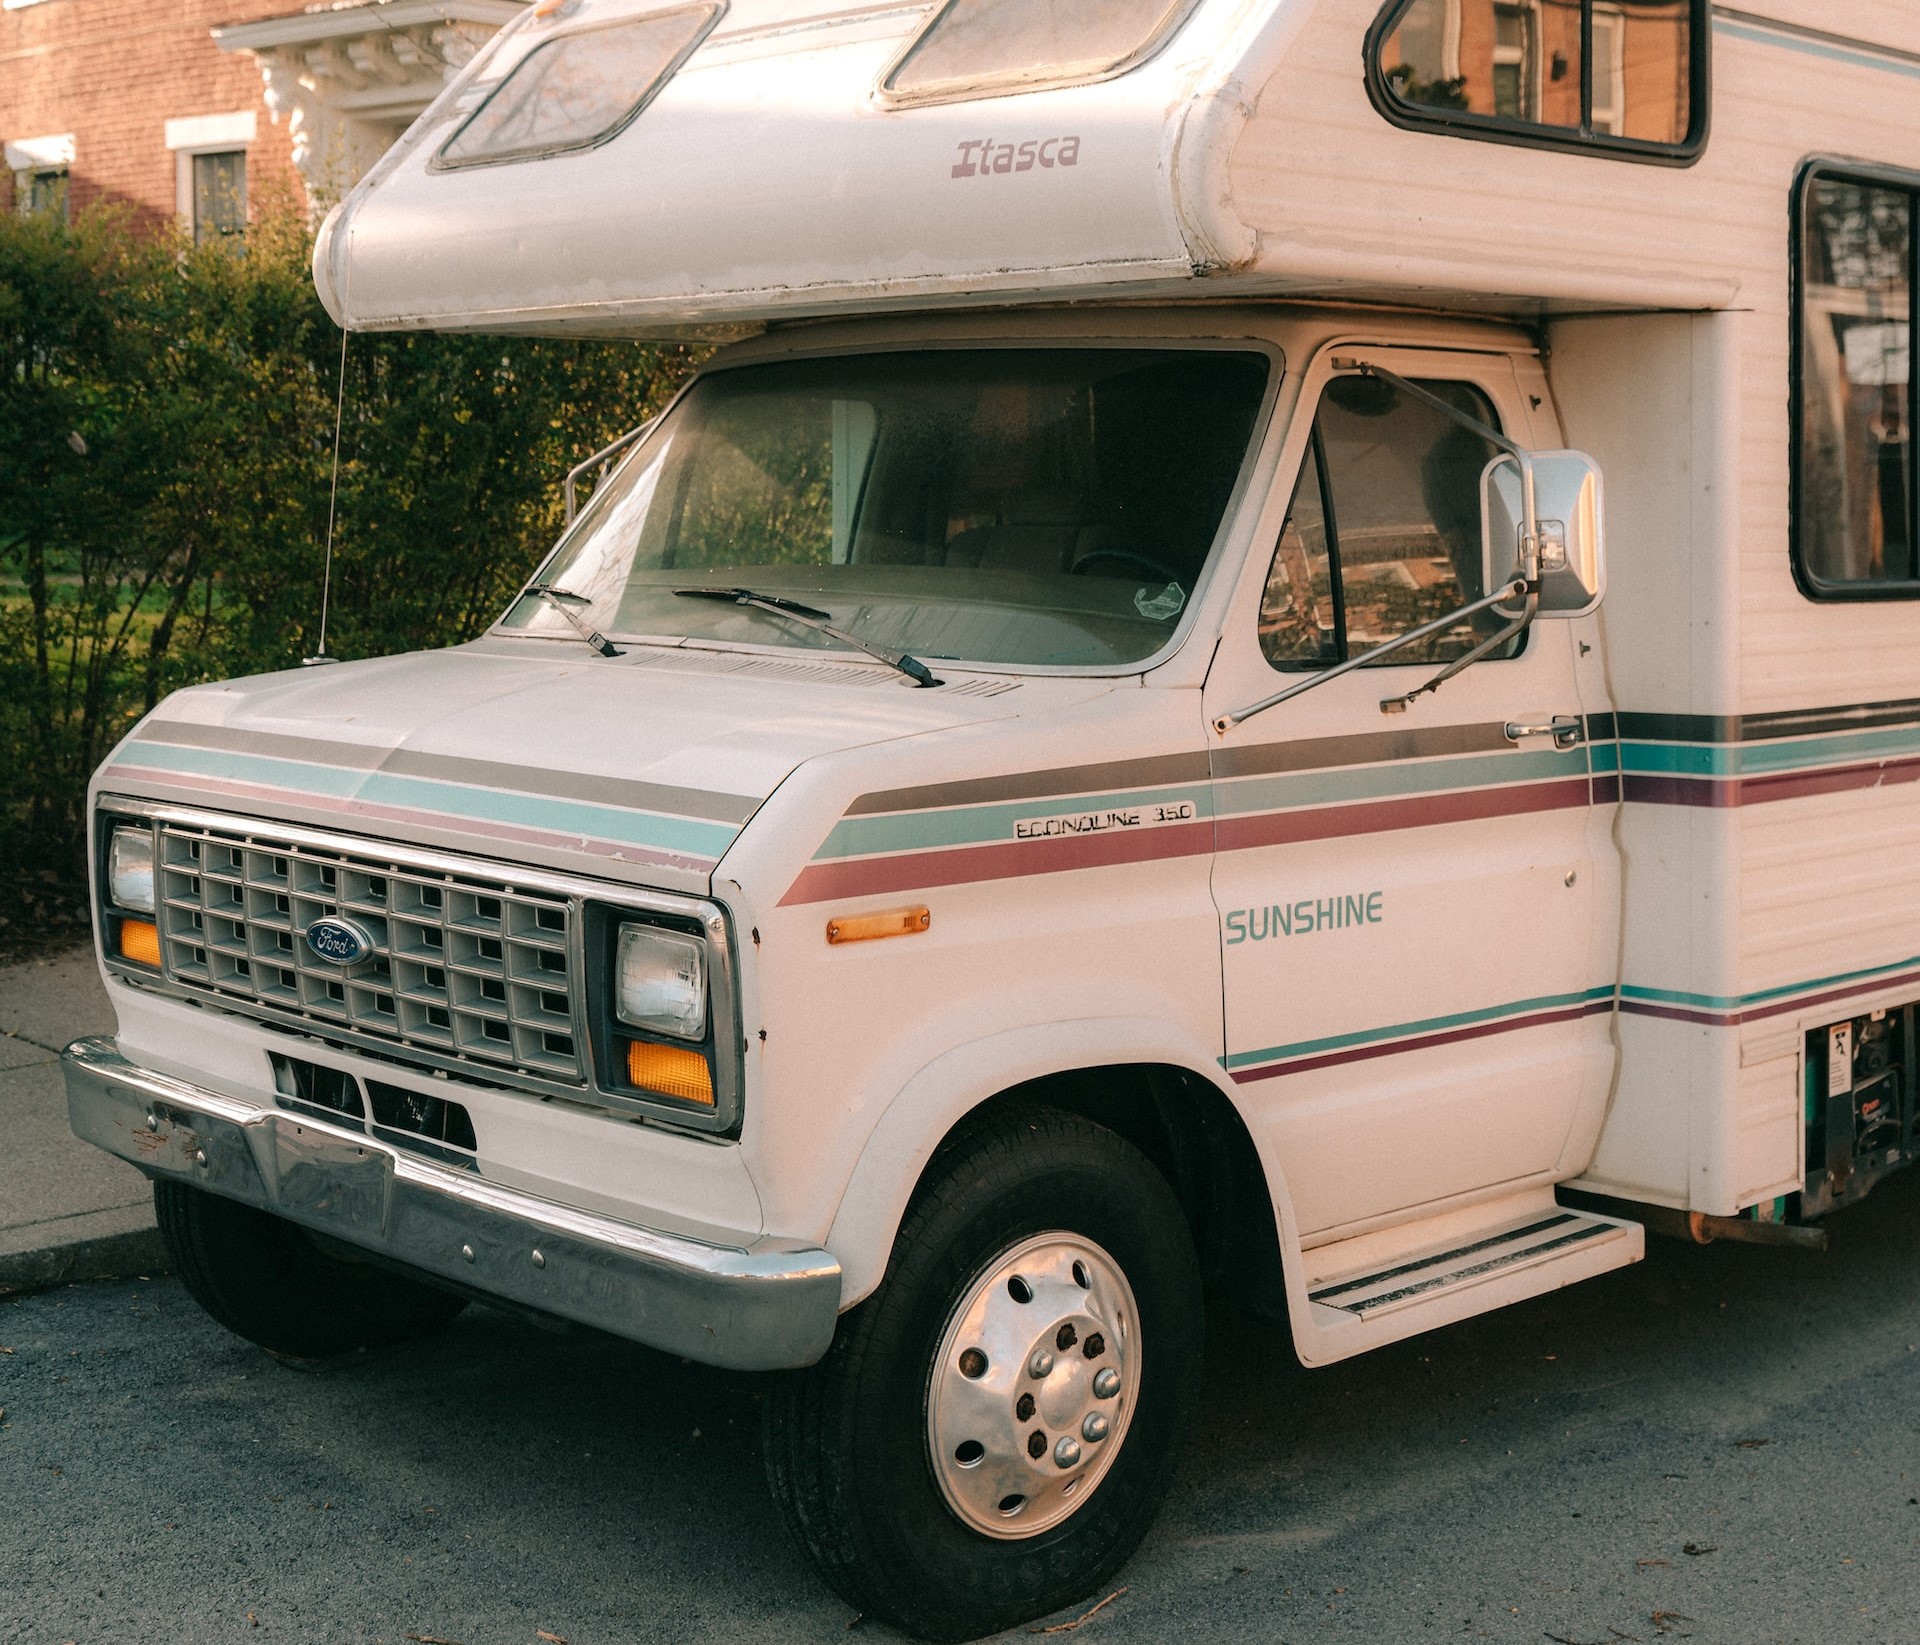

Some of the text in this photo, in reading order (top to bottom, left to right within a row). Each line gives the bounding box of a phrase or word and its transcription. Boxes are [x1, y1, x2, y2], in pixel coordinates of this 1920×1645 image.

[951, 136, 1080, 178] Itasca
[1226, 891, 1383, 945] SUNSHINE
[318, 927, 348, 954] Ford
